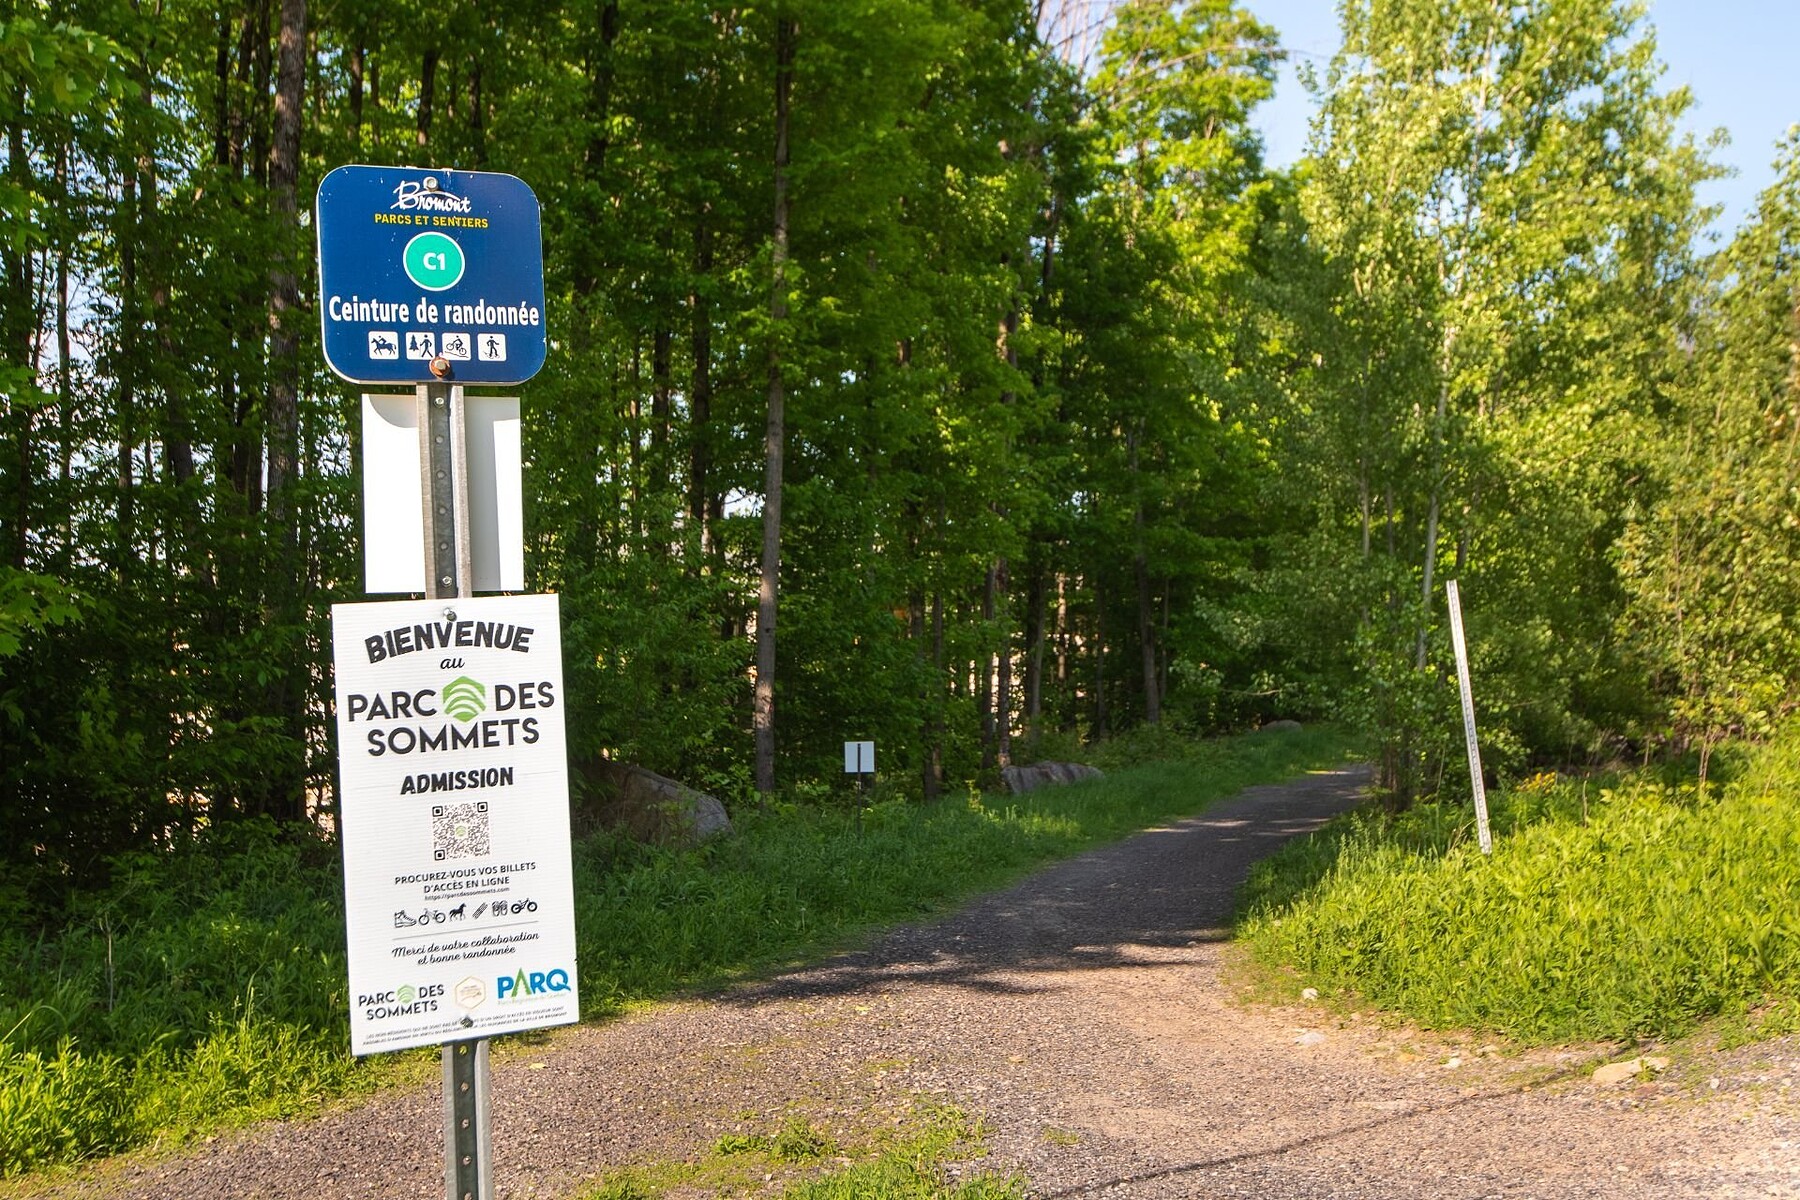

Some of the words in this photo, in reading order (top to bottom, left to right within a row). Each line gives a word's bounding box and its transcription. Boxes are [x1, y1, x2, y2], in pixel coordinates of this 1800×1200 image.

[390, 180, 472, 213] Bromont
[374, 213, 412, 225] PARCS
[415, 215, 429, 226] ET
[432, 216, 489, 228] SENTIERS
[423, 252, 446, 271] C1
[329, 296, 409, 322] Ceinture
[416, 297, 439, 324] de
[445, 298, 540, 326] randonnée
[364, 620, 534, 664] BIENVENUE
[440, 657, 465, 669] au
[348, 689, 438, 722] PARC
[494, 681, 555, 712] DES
[367, 717, 540, 757] SOMMETS
[400, 766, 514, 795] ADMISSION
[395, 868, 476, 885] PROCUREZ-VOUS
[479, 866, 498, 876] VOS
[500, 862, 536, 873] BILLETS
[466, 879, 479, 889] EN
[481, 876, 510, 887] LIGNE
[391, 944, 425, 958] Merci
[427, 943, 440, 953] de
[442, 940, 469, 951] votre
[470, 931, 540, 947] collaboration
[417, 956, 429, 965] et
[429, 953, 461, 964] bonne
[463, 945, 516, 959] randonnée
[359, 991, 395, 1007] PARC
[419, 984, 445, 998] DES
[497, 967, 572, 1000] PARQ
[367, 1000, 438, 1020] SOMMETS
